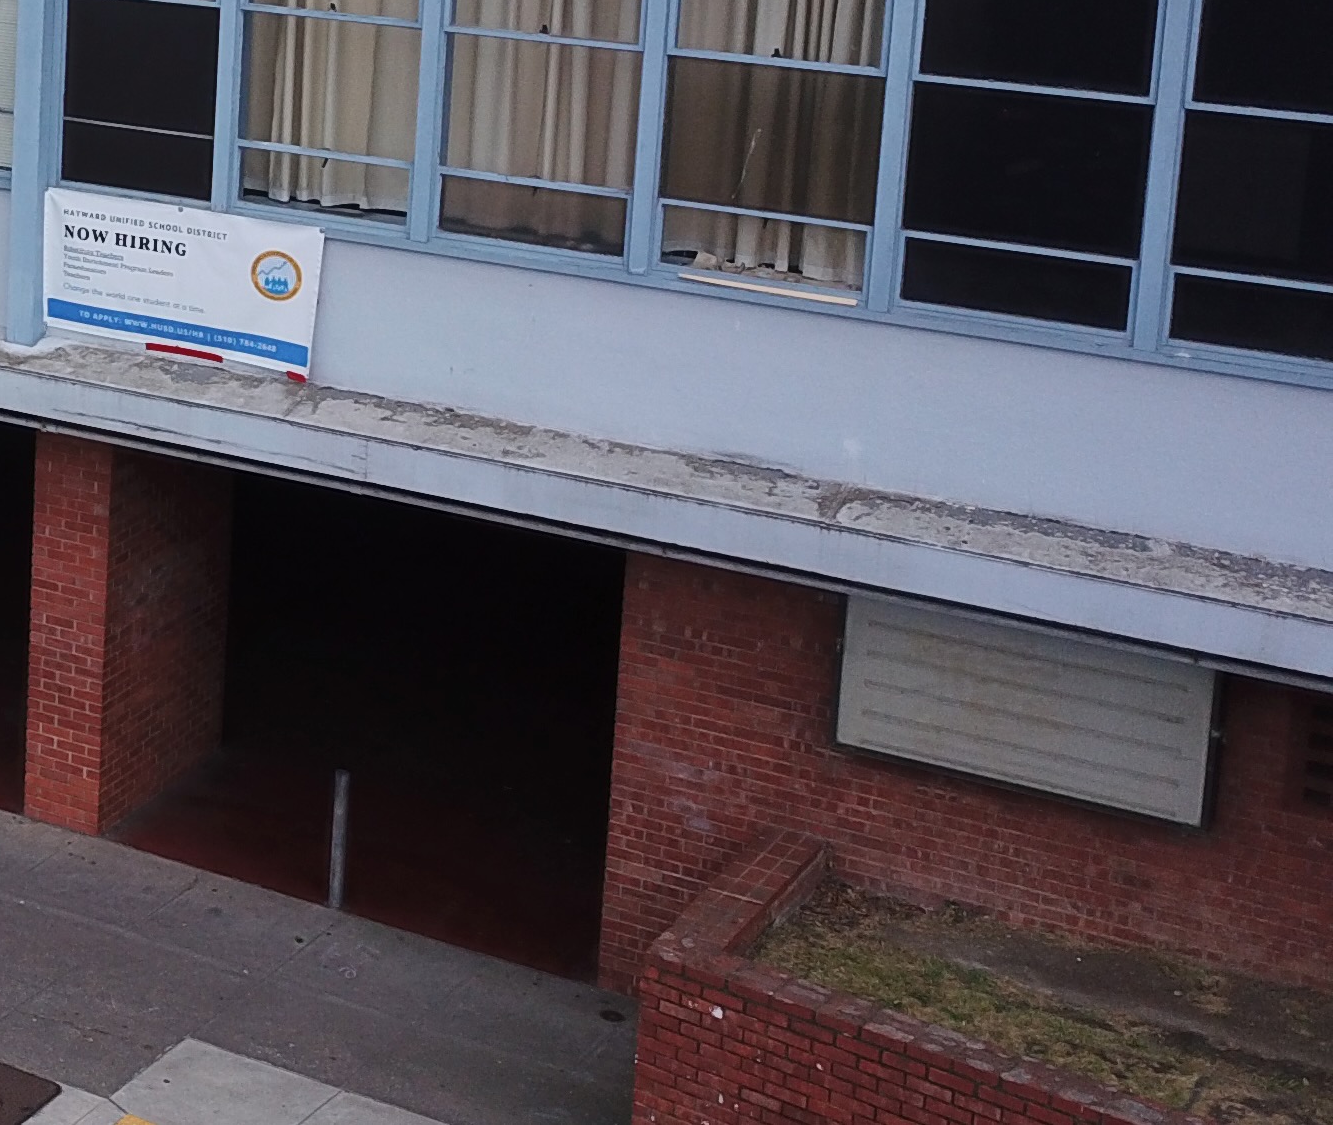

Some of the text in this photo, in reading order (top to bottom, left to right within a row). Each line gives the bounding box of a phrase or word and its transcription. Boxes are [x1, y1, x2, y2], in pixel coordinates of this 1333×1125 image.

[63, 208, 227, 240] HAYWARD UNIFIED SCHOOL DISTRICT
[64, 224, 109, 243] NOW
[115, 232, 187, 256] HIRING
[79, 310, 90, 318] TO
